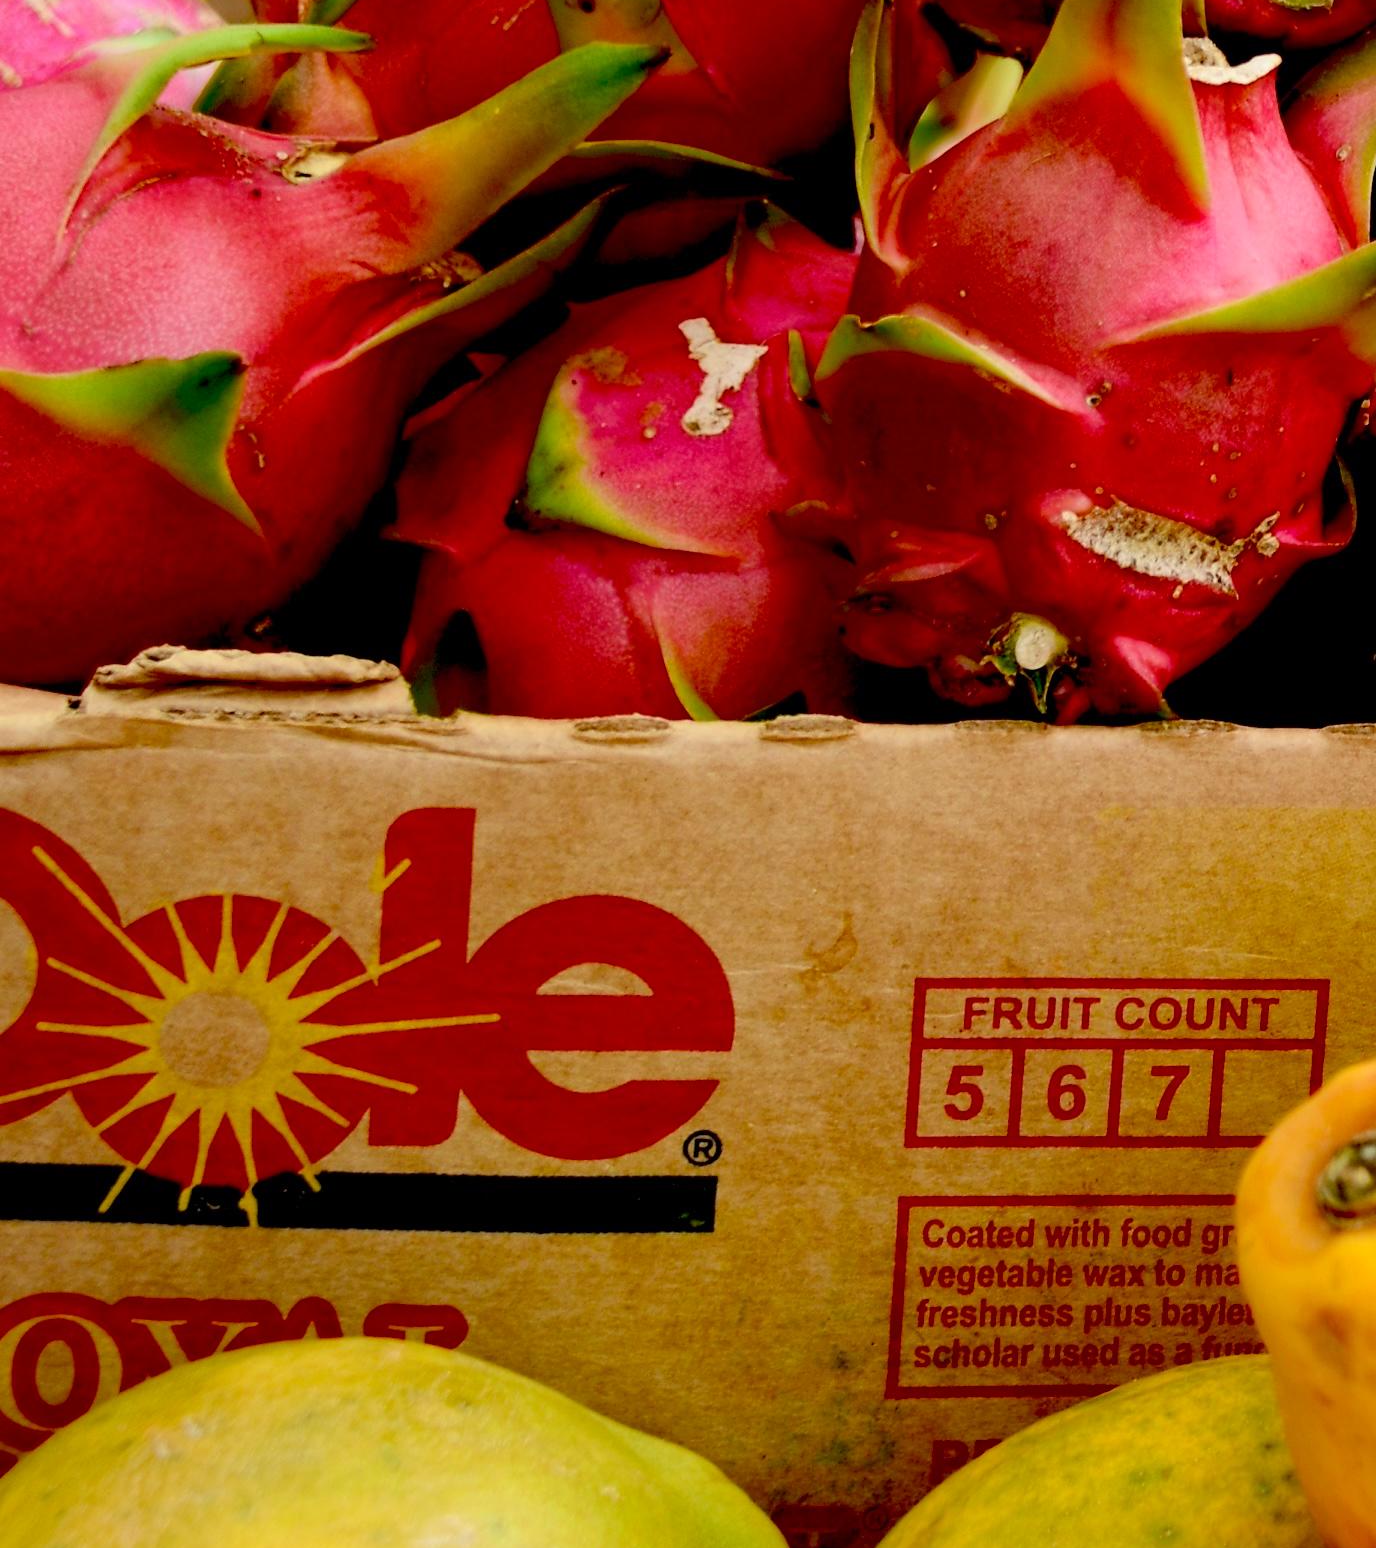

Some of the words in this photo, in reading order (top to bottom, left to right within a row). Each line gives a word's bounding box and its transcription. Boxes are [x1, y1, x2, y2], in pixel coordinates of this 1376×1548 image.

[961, 995, 1101, 1031] FRUIT
[1114, 996, 1280, 1032] COUNT
[943, 1064, 985, 1121] 5
[1046, 1064, 1088, 1121] 6
[1149, 1064, 1191, 1121] 7
[922, 1218, 1035, 1249] Coated
[1045, 1217, 1110, 1249] with
[1120, 1217, 1192, 1249] food
[1201, 1223, 1236, 1255] gr
[918, 1258, 1074, 1295] vegetable
[1082, 1263, 1147, 1288] wax
[1153, 1258, 1186, 1287] to
[1194, 1263, 1241, 1287] ma
[915, 1298, 1074, 1329] freshness
[1082, 1297, 1152, 1334] plus
[913, 1337, 1035, 1369] scholar
[1041, 1336, 1119, 1368] used
[1128, 1343, 1165, 1367] as
[1172, 1342, 1194, 1366] a
